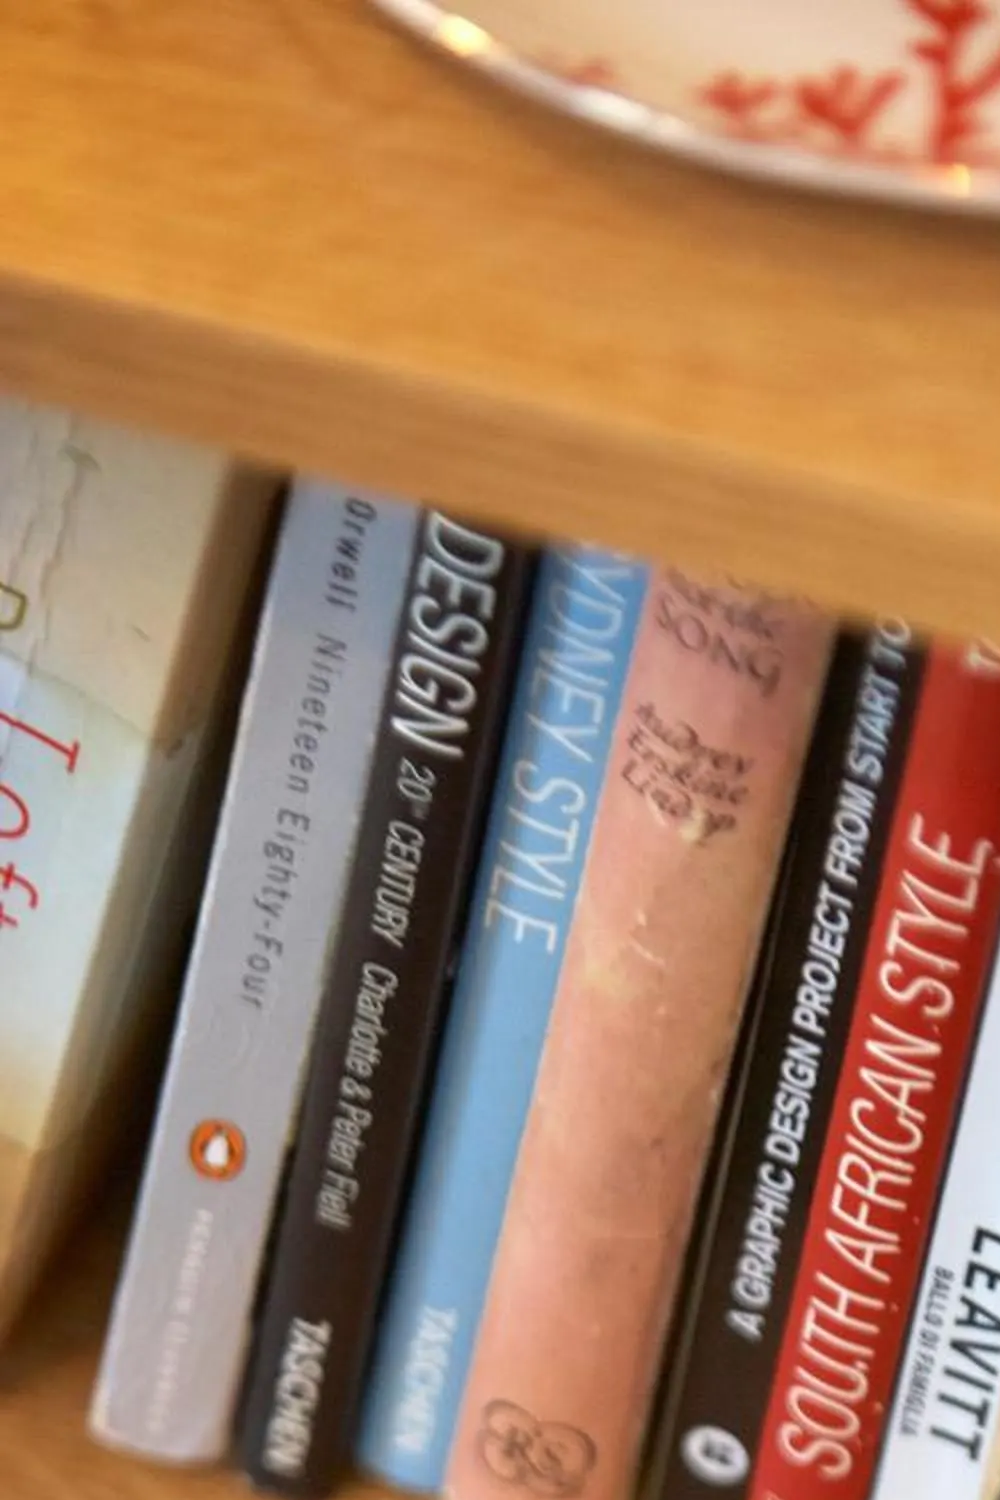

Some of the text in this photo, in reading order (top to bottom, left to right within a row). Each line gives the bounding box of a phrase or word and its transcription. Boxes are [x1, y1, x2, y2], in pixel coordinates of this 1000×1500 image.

[391, 510, 504, 760] DESIGN
[239, 497, 377, 1011] Orwell Nineteen Eighty-Four
[484, 545, 632, 955] YDNEY STYLE
[372, 818, 426, 948] CENTURY
[877, 814, 993, 1020] STYLE
[346, 962, 399, 1078] Charlotte
[725, 615, 912, 1342] A GRAPHIC DESIGN PROJECT FROM START TO
[328, 1099, 373, 1171] Peter
[340, 1076, 373, 1102] &
[825, 1013, 942, 1284] AFRICAN
[394, 1306, 459, 1455] TASCHEN
[776, 1272, 885, 1481] SOUTH
[923, 1265, 953, 1329] BALLO
[264, 1317, 331, 1478] TASCHEN
